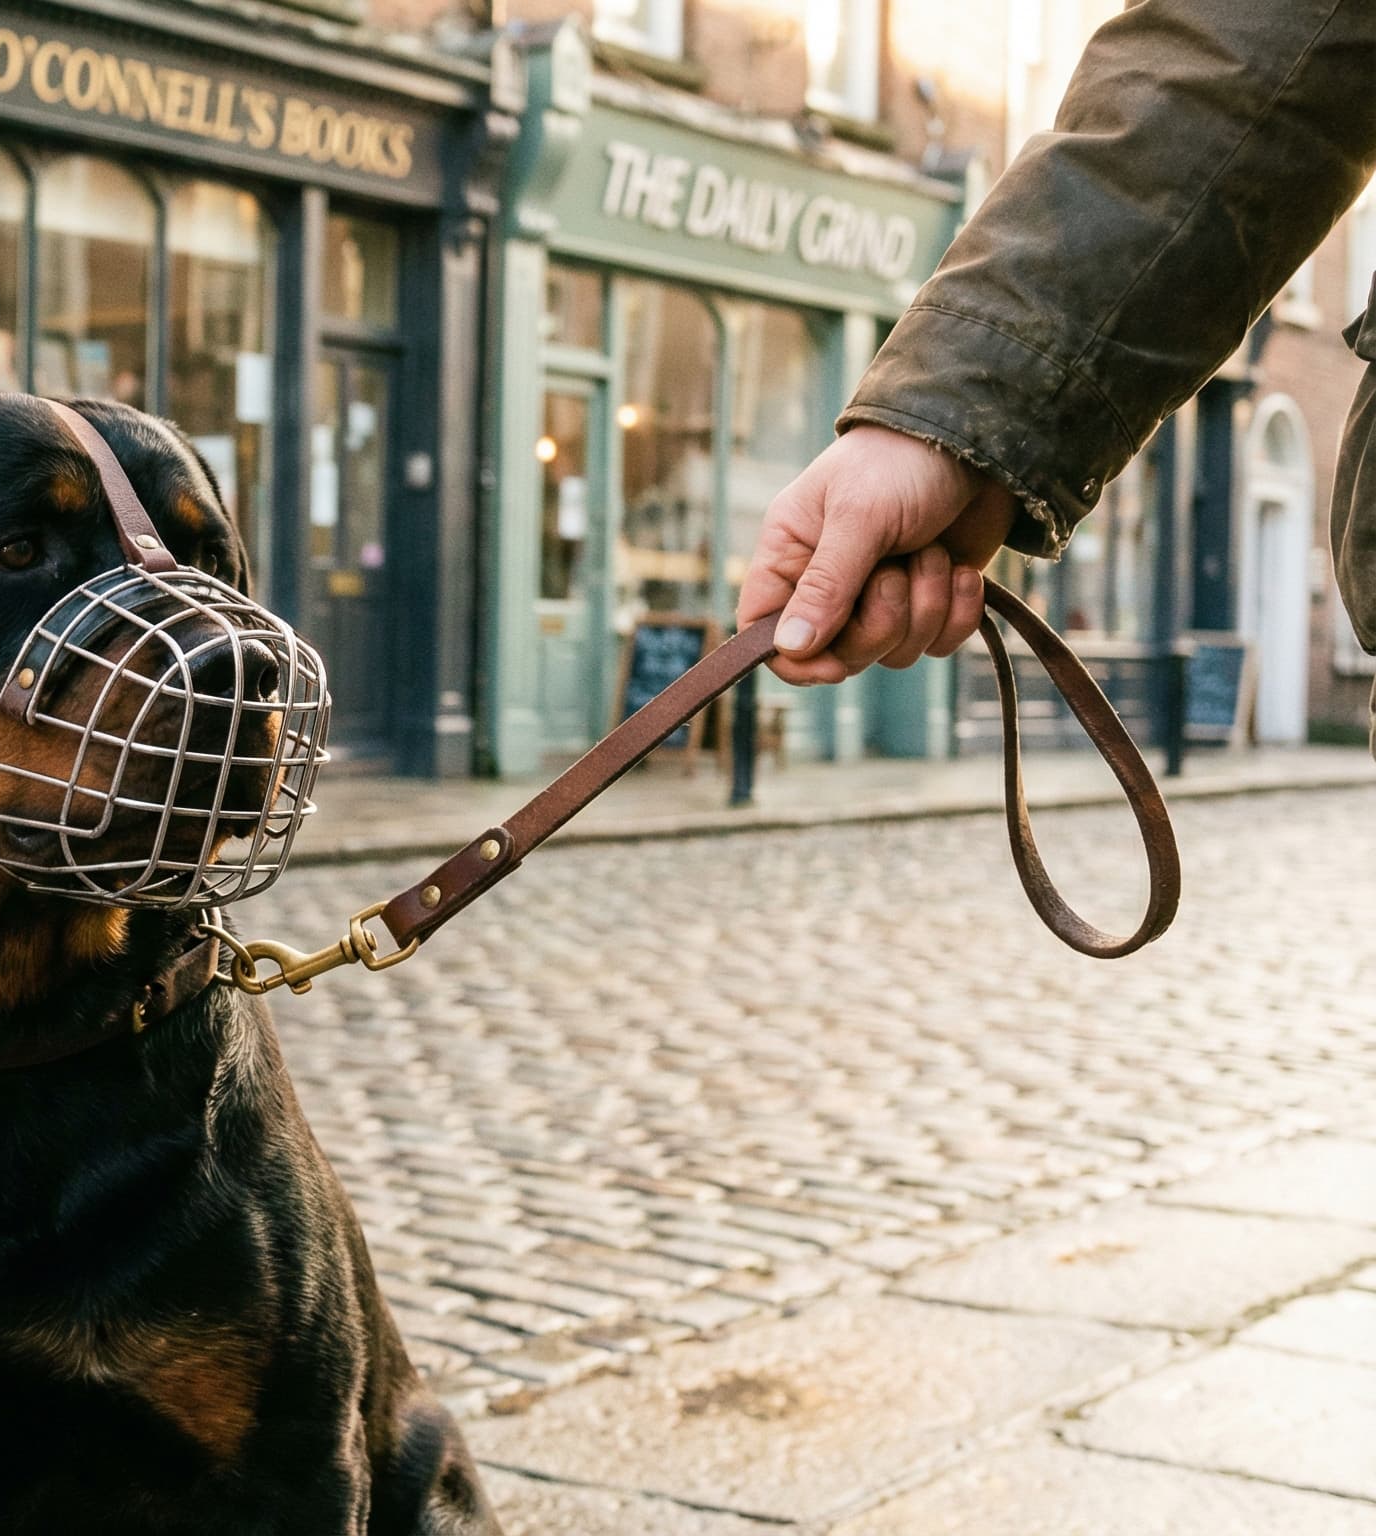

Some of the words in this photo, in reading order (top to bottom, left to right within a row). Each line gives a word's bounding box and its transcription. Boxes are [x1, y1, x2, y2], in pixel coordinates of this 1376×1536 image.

[280, 97, 414, 178] BOOKS
[603, 141, 690, 229] THE
[686, 165, 805, 254] DAILY
[799, 196, 916, 280] GRIND
